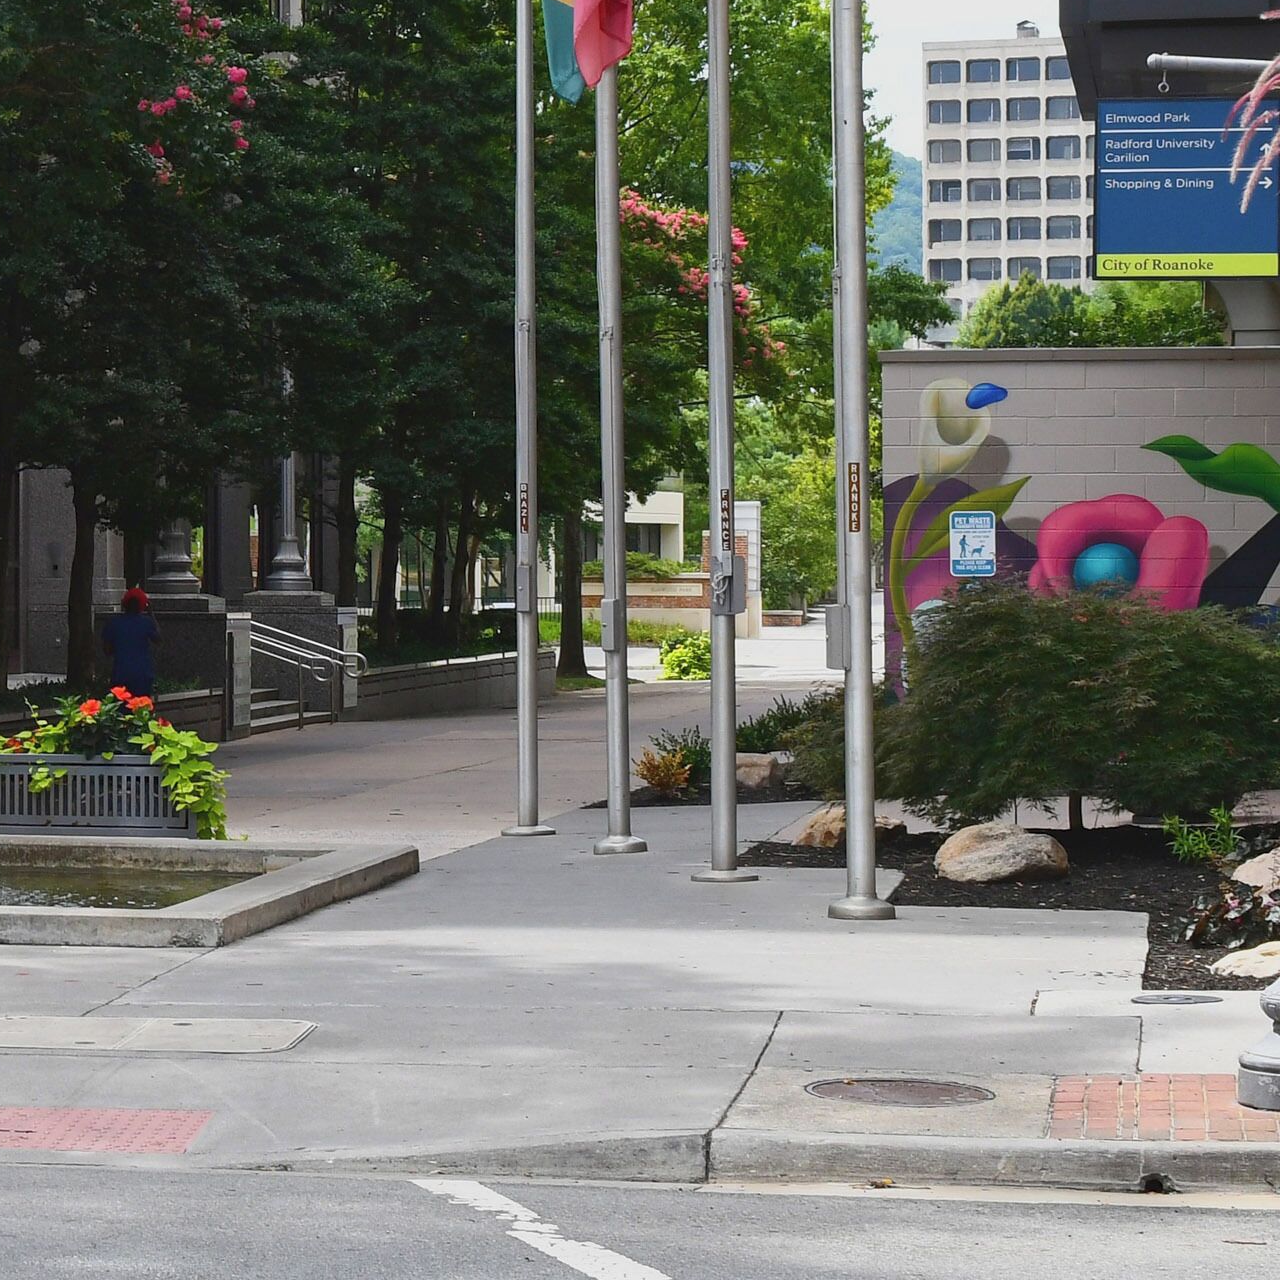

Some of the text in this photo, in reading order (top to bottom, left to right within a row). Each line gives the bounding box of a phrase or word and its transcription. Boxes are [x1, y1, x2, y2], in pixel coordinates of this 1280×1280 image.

[1105, 112, 1191, 124] Elmwood Park
[1105, 138, 1215, 150] Radford University
[1105, 152, 1150, 163] Carilion
[1105, 178, 1214, 190] Shopping & Dining
[1102, 258, 1214, 274] City of Roanoke
[850, 464, 859, 531] ROANOKE
[520, 484, 528, 533] BRAZIL
[721, 490, 730, 550] FRANCE
